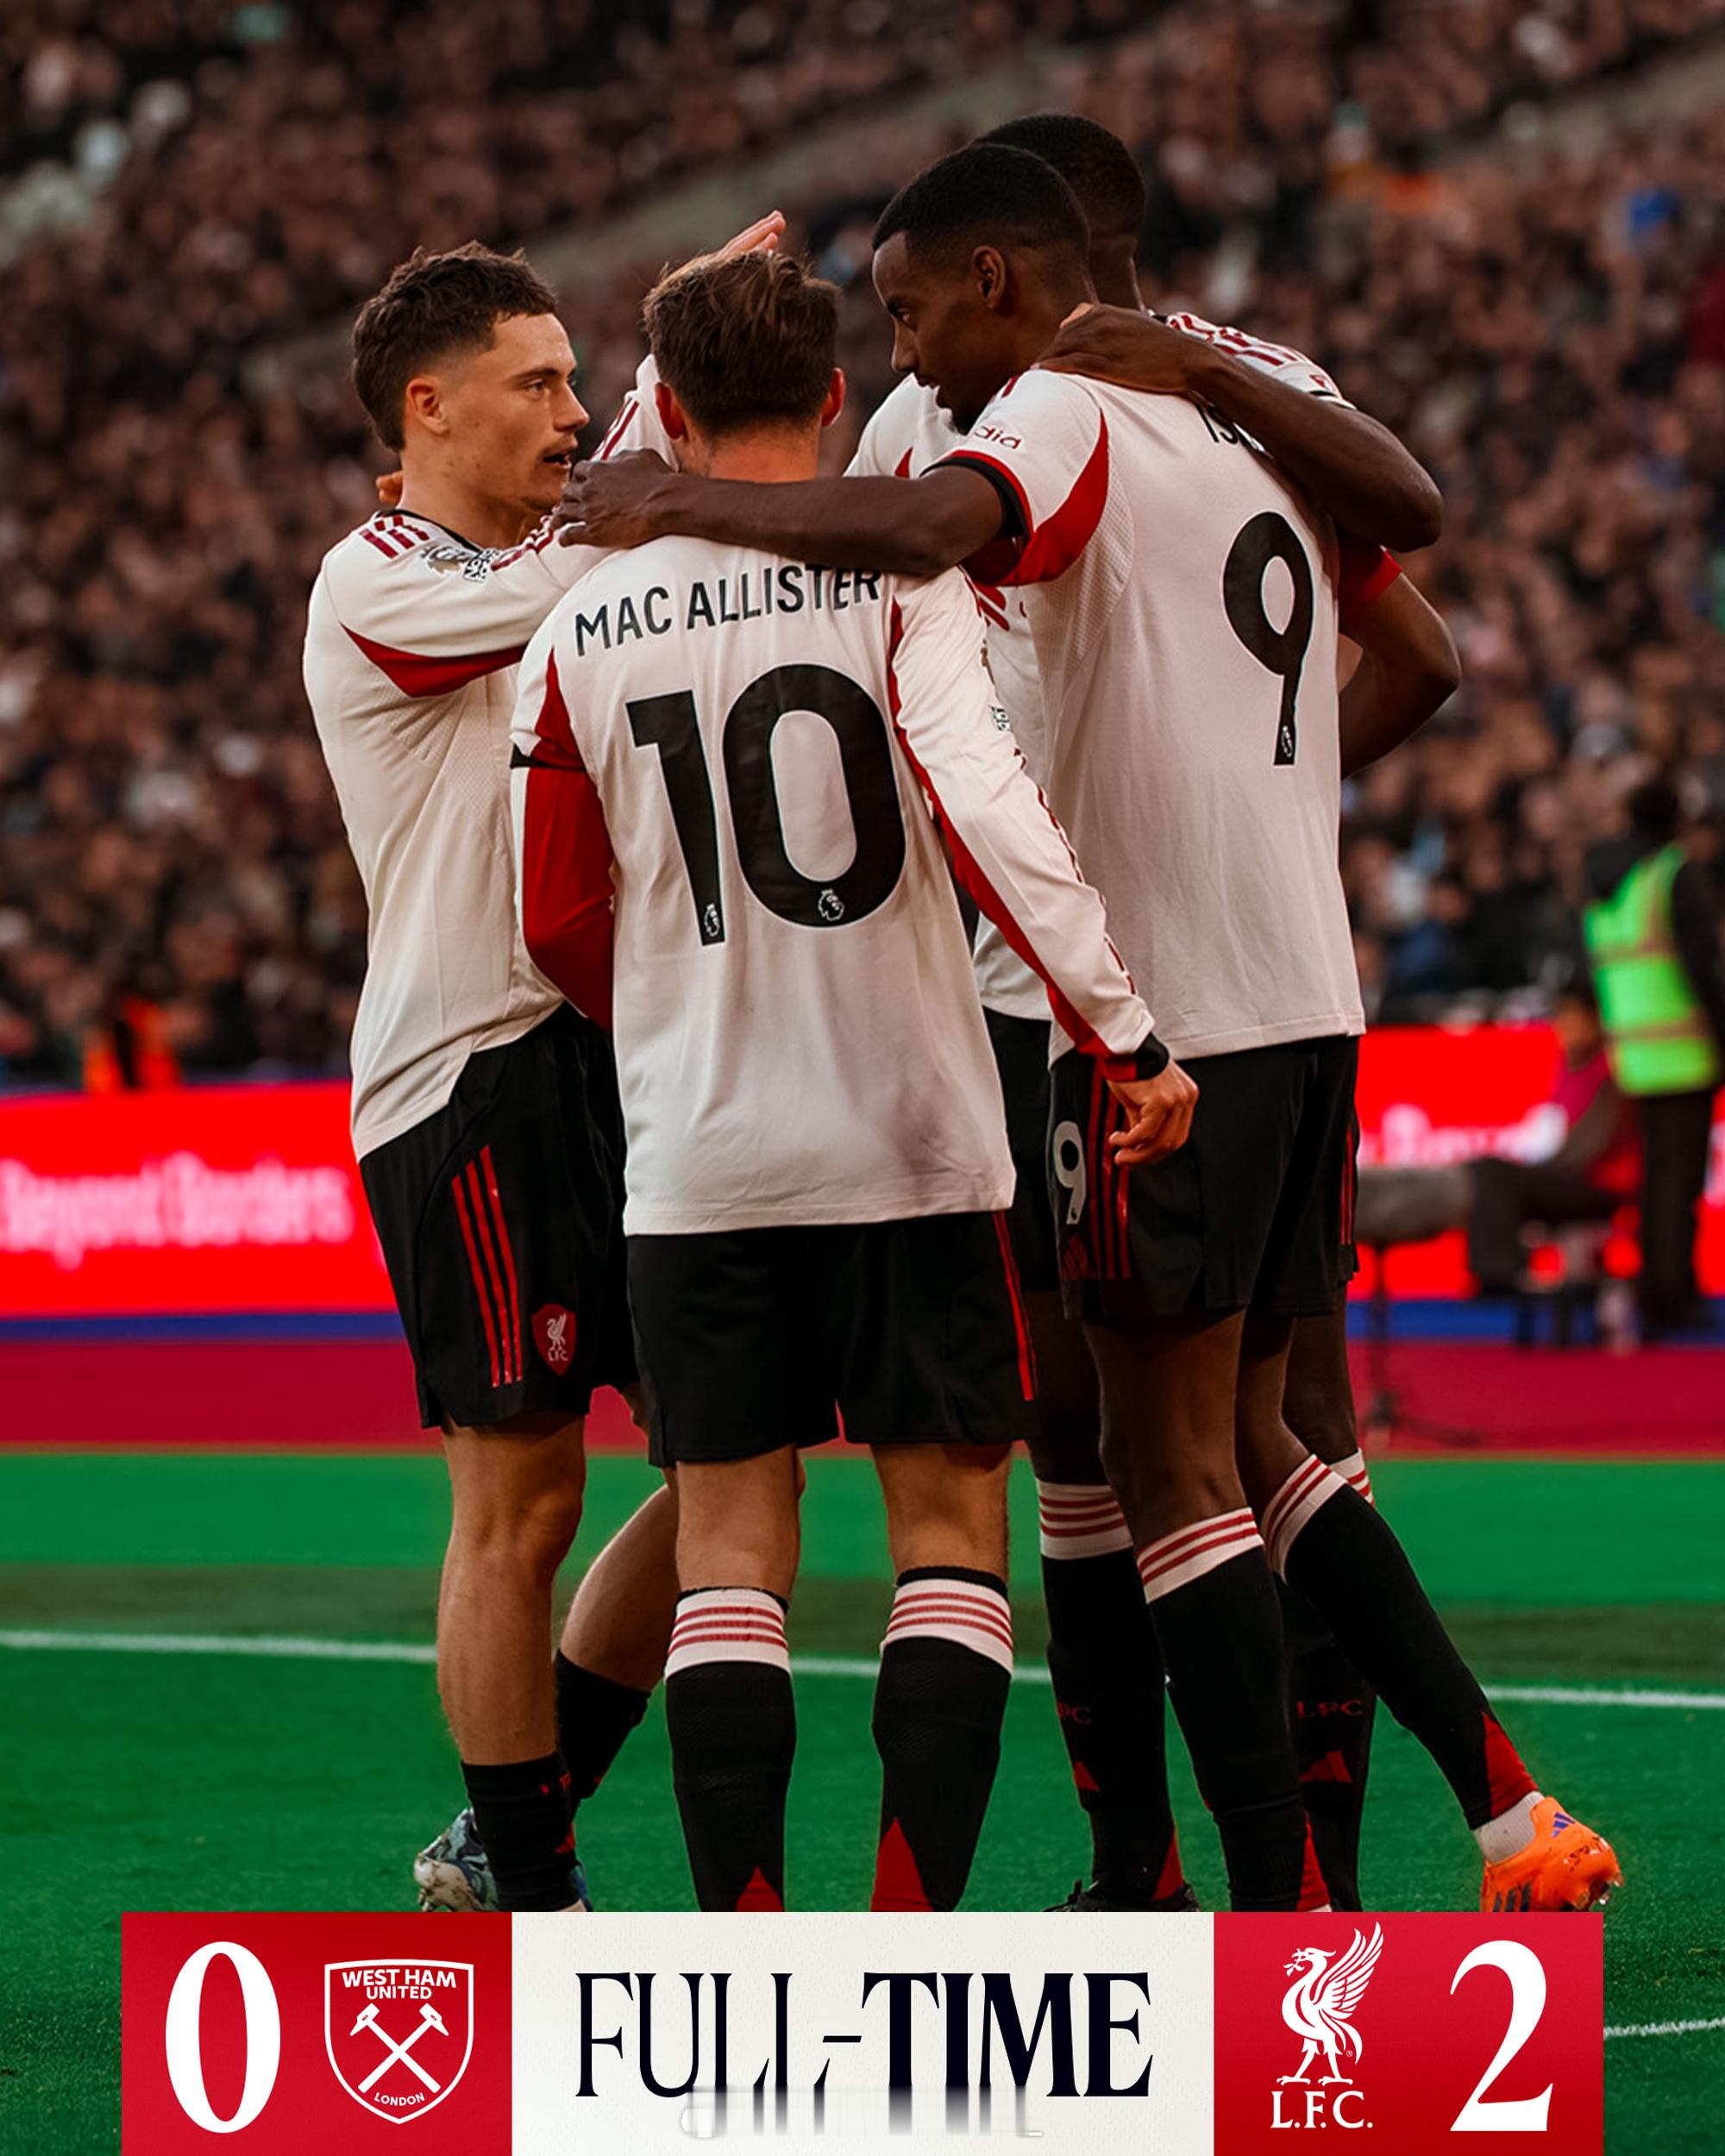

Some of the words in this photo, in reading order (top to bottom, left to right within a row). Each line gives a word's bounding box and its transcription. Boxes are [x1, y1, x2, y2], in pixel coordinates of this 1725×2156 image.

[574, 586, 672, 657] MAC
[687, 565, 881, 630] ALLISTER
[1223, 511, 1315, 766] 9
[627, 664, 907, 946] 10
[1053, 1120, 1087, 1225] 9
